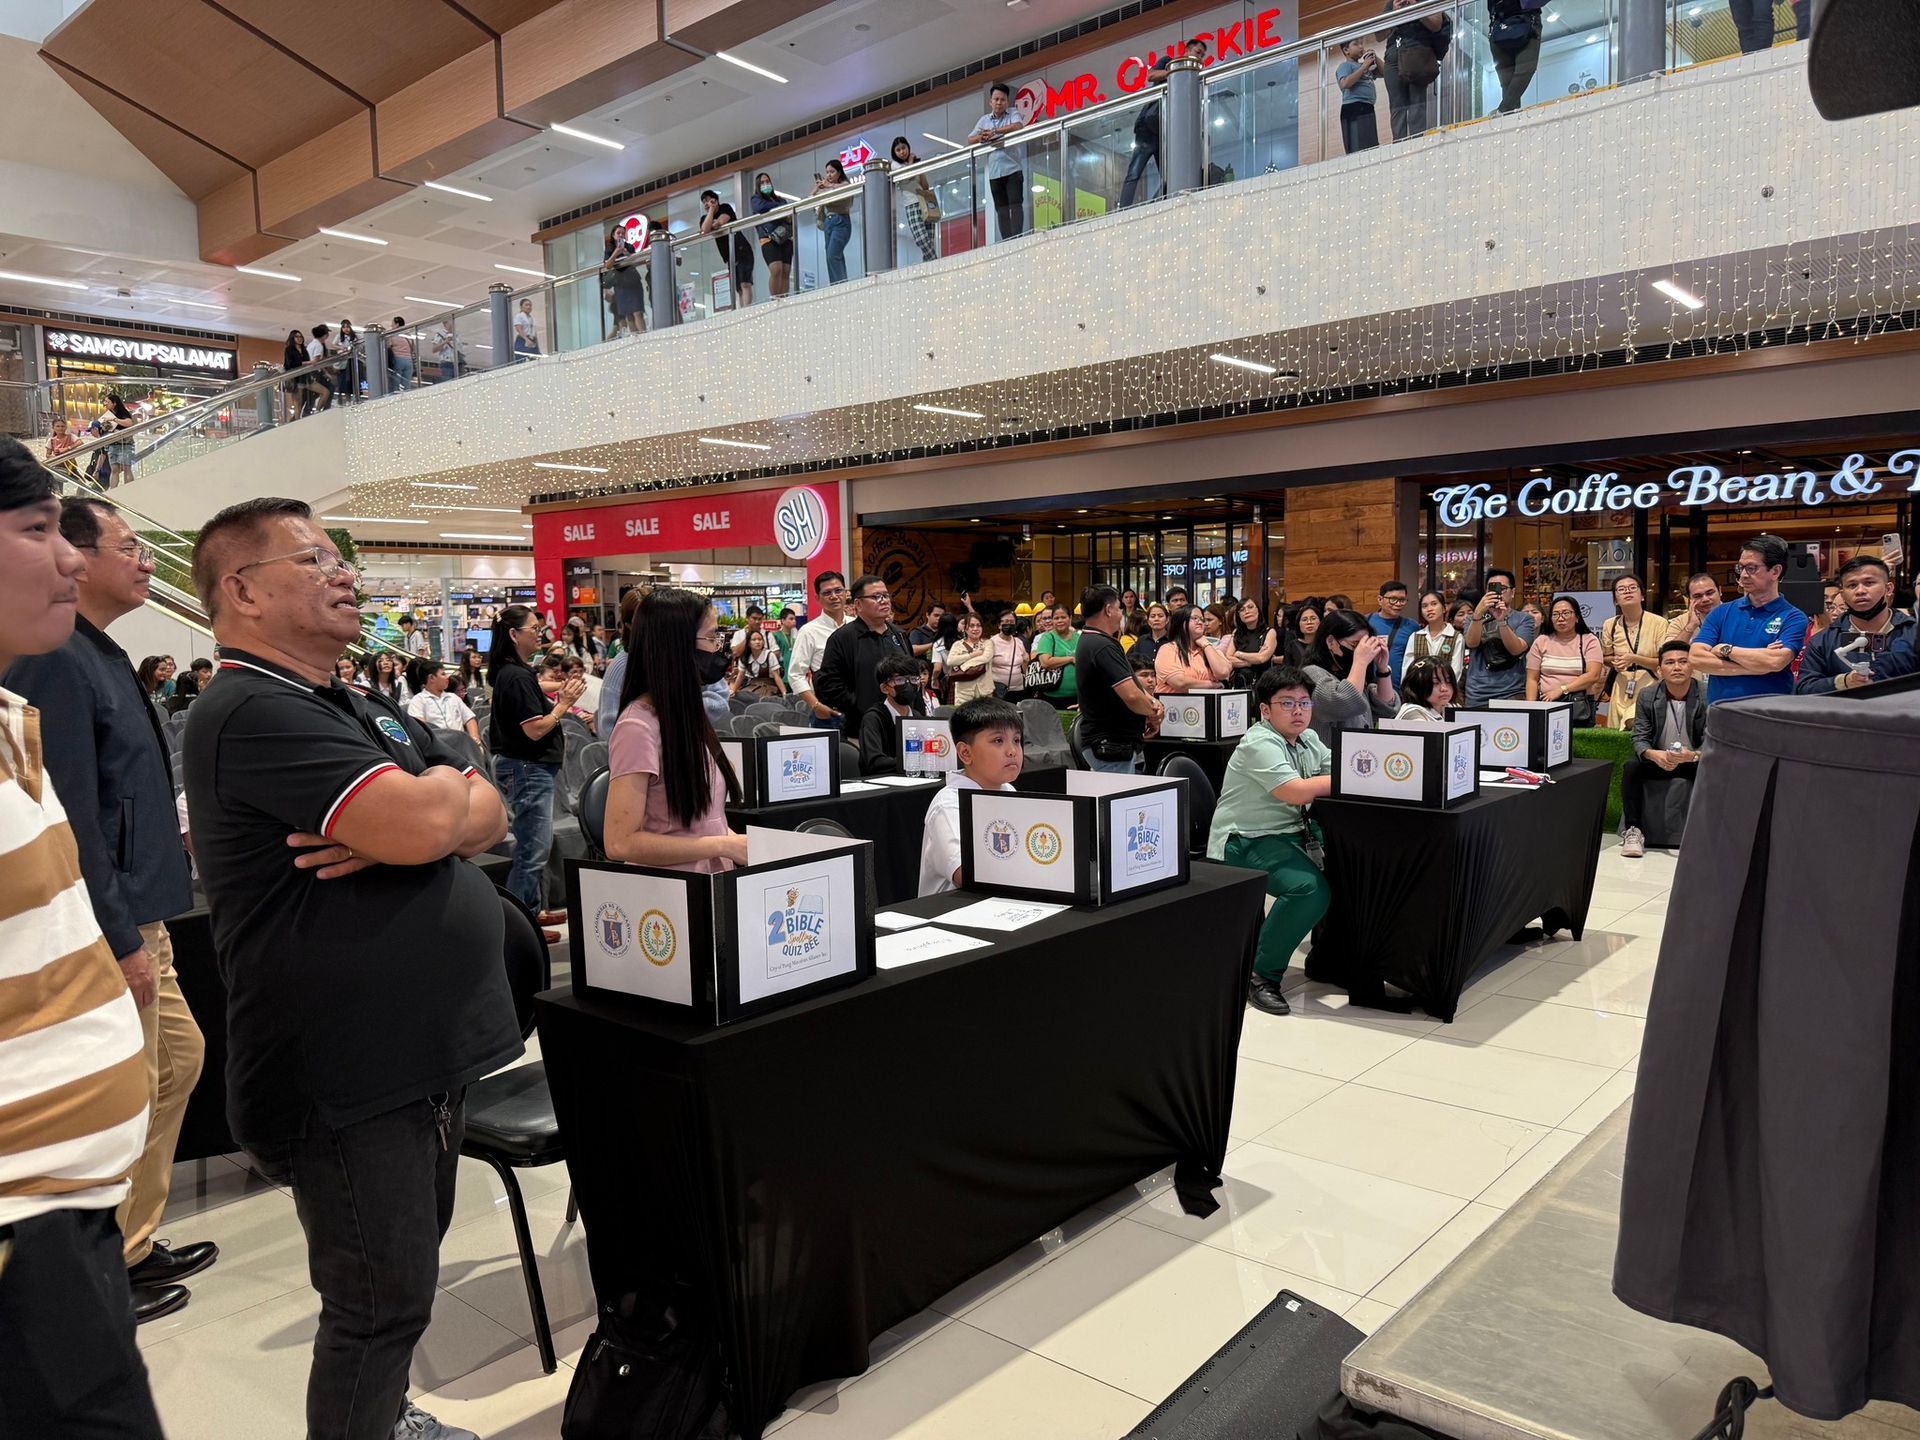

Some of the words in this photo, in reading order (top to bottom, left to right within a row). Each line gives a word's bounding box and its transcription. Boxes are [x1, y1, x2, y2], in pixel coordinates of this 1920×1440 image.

[1046, 73, 1107, 117] MR.
[70, 334, 232, 370] SAMGYUPSALAMAT
[1433, 483, 1507, 527] The
[1517, 472, 1660, 516] Coffee
[1668, 465, 1824, 506] Bean
[1831, 453, 1882, 496] &
[625, 518, 660, 537] SALE
[692, 510, 731, 531] SALE
[777, 491, 819, 552] SM
[563, 523, 595, 542] SALE
[792, 763, 813, 776] BIBLE
[1128, 826, 1138, 852] 2
[1138, 830, 1160, 847] BIBLE
[768, 910, 786, 945] 2
[786, 914, 824, 935] BIBLE
[782, 944, 802, 957] QUIZ
[803, 936, 819, 953] BEE
